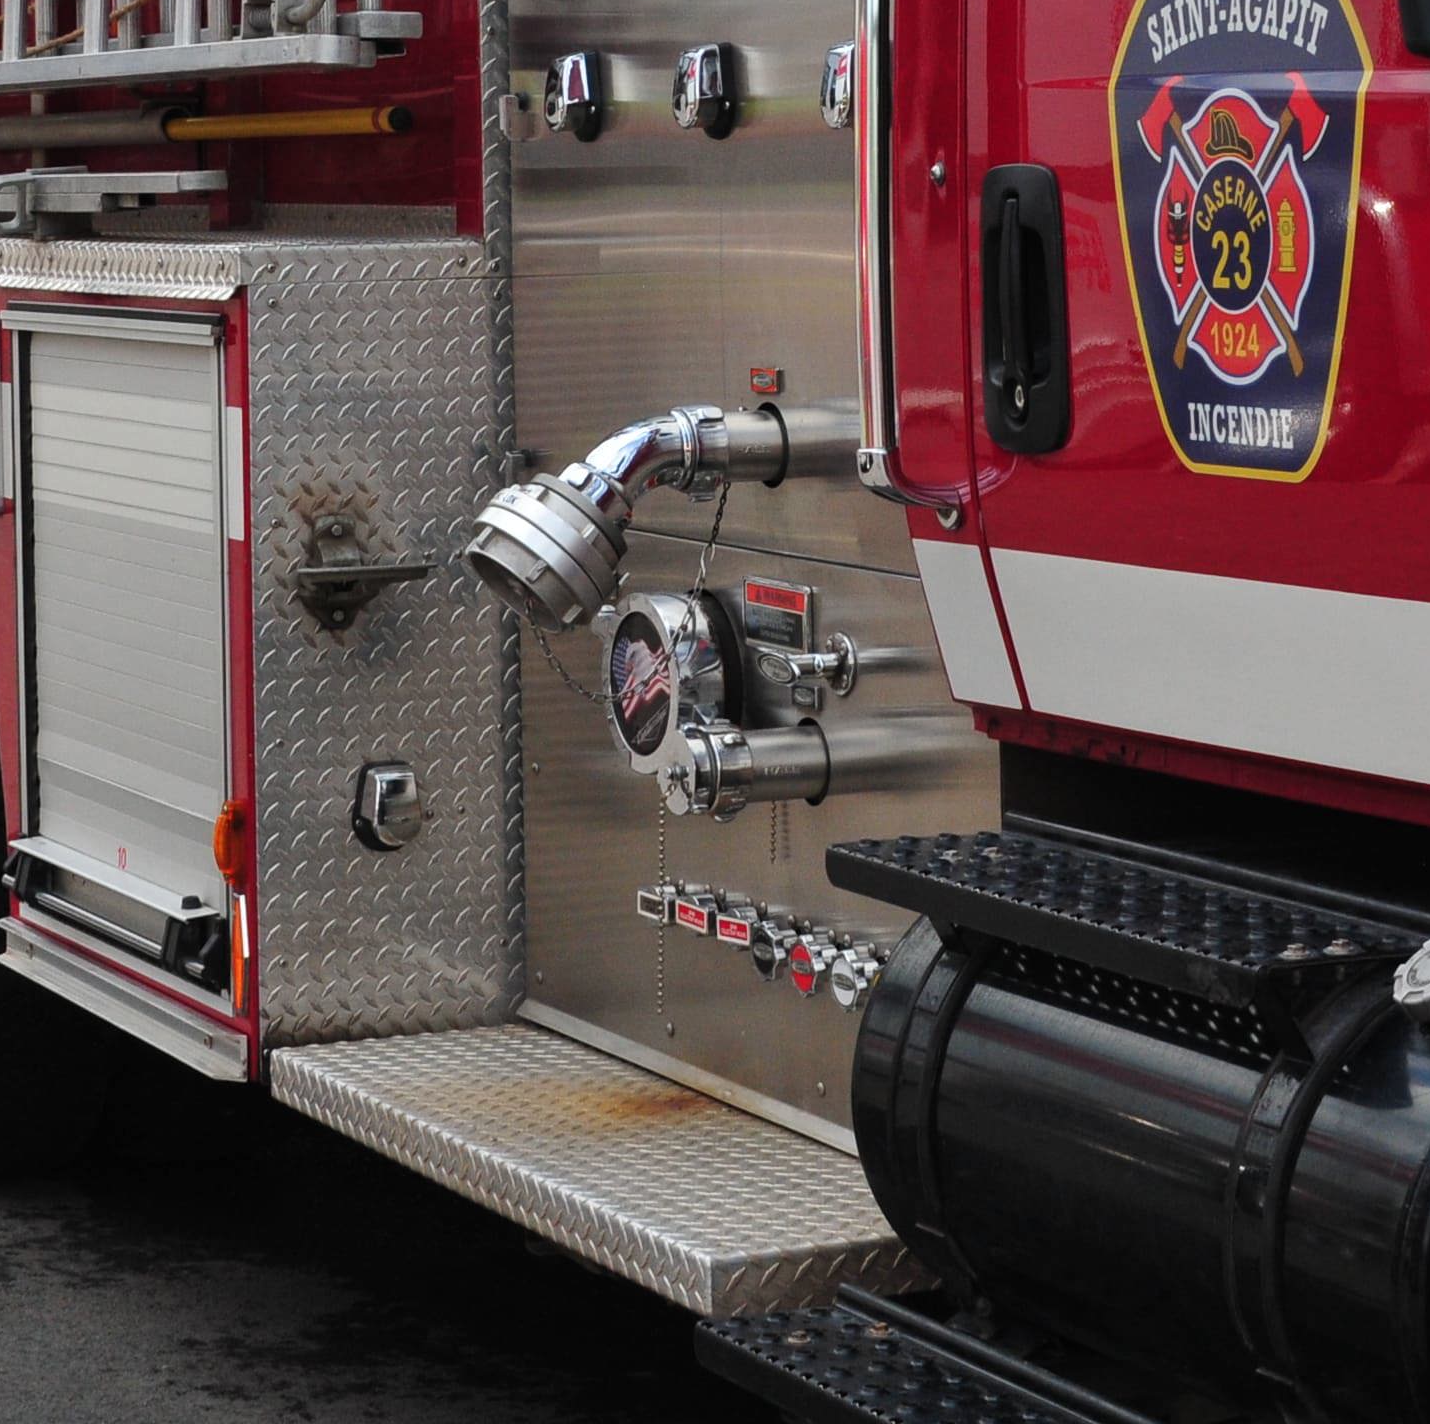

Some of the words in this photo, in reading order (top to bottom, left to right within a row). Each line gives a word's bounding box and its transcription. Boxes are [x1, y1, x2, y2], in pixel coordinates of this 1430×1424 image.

[1196, 176, 1266, 232] CASERNE
[1212, 230, 1252, 290] 23
[1211, 321, 1260, 358] 1924
[1187, 402, 1294, 450] INCENDIE
